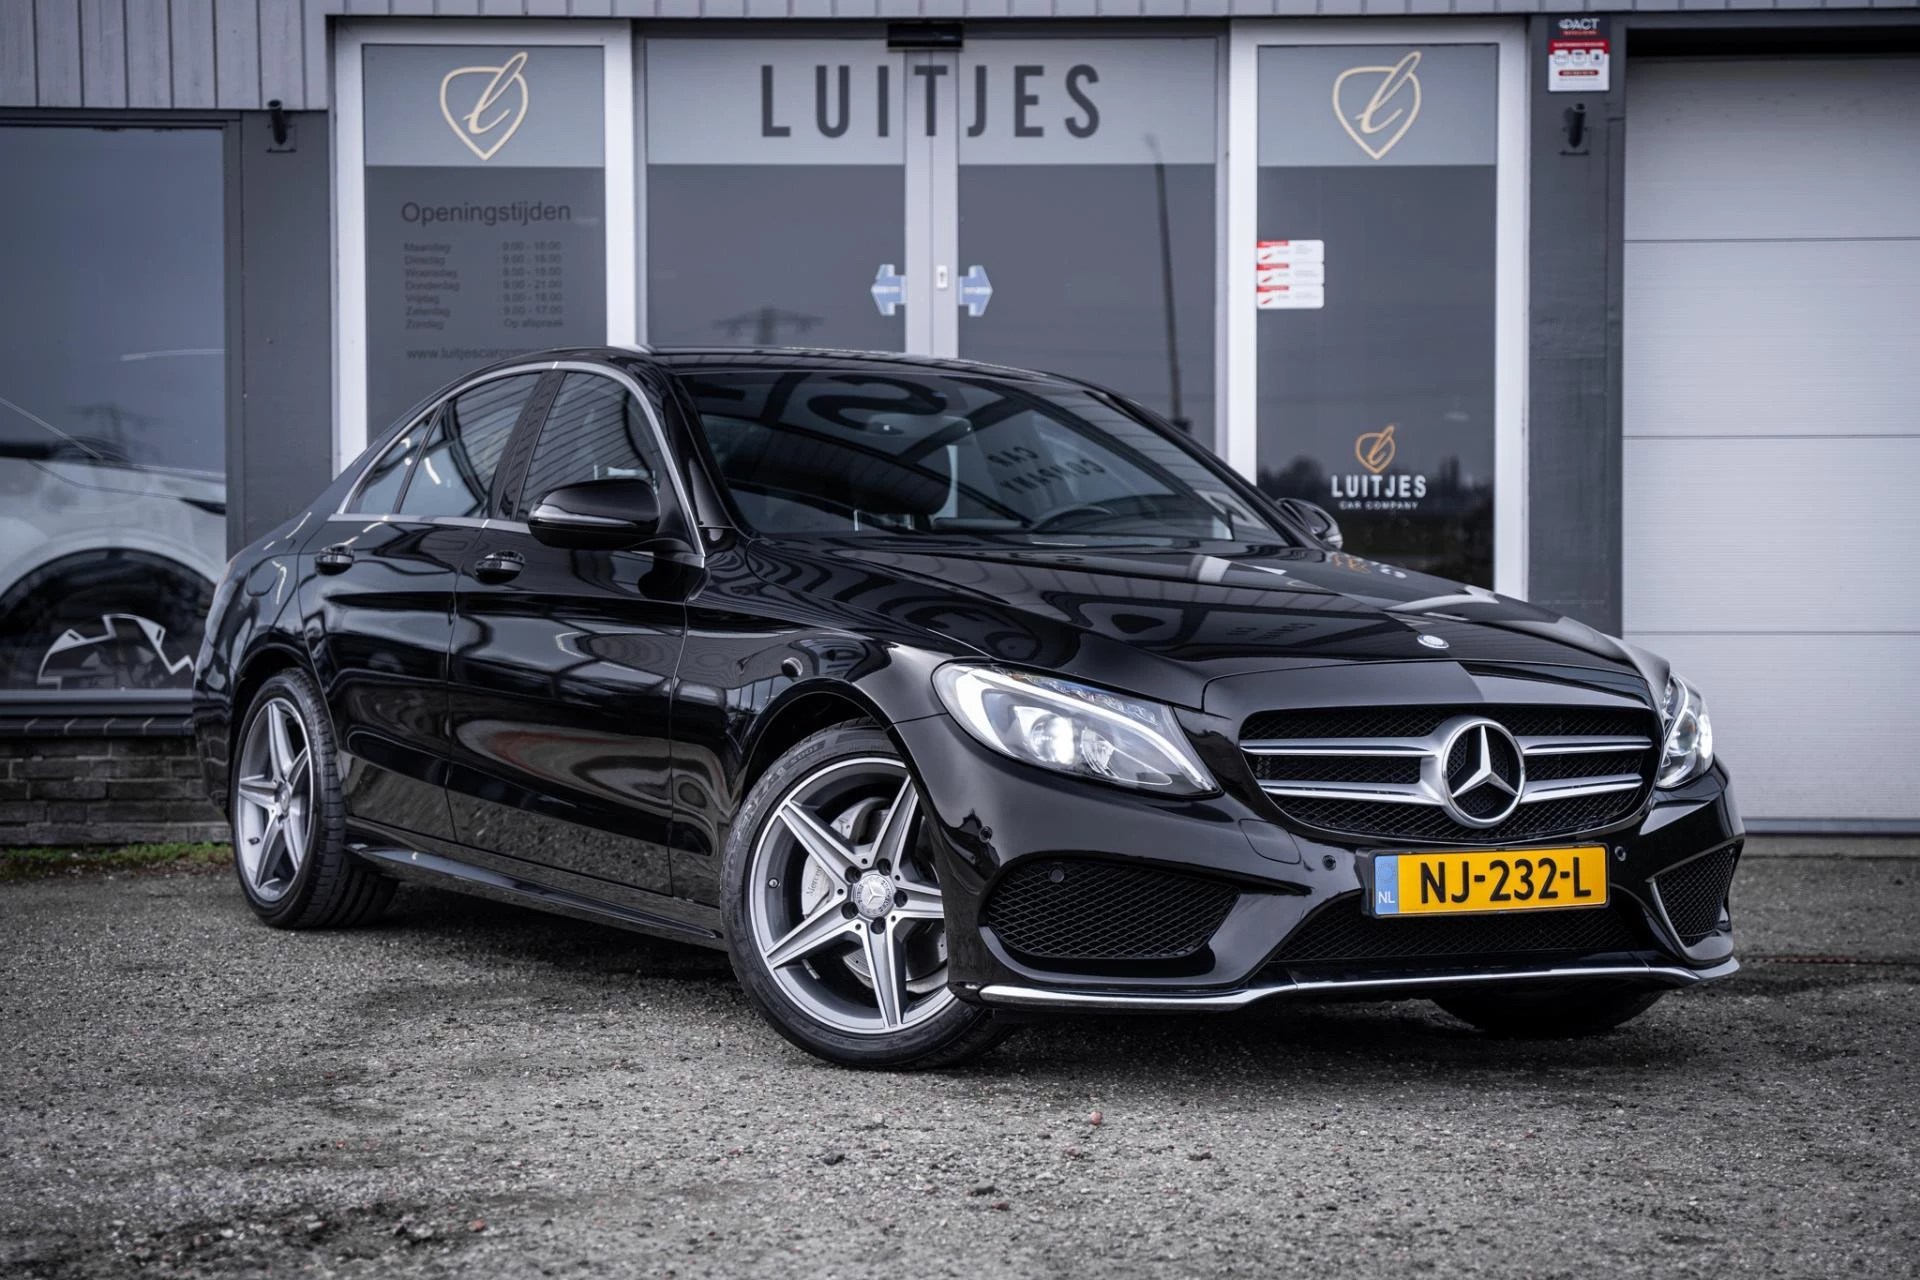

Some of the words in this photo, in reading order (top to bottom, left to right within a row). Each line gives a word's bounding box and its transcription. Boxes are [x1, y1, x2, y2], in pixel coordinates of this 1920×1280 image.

[761, 64, 1100, 138] LUITJES
[401, 201, 571, 226] Openingstijden
[1331, 475, 1427, 498] LUITJES
[1339, 501, 1361, 510] CAR
[1365, 501, 1418, 510] COMPANY
[1378, 891, 1396, 904] NL
[1420, 857, 1592, 904] NJ-232-L
